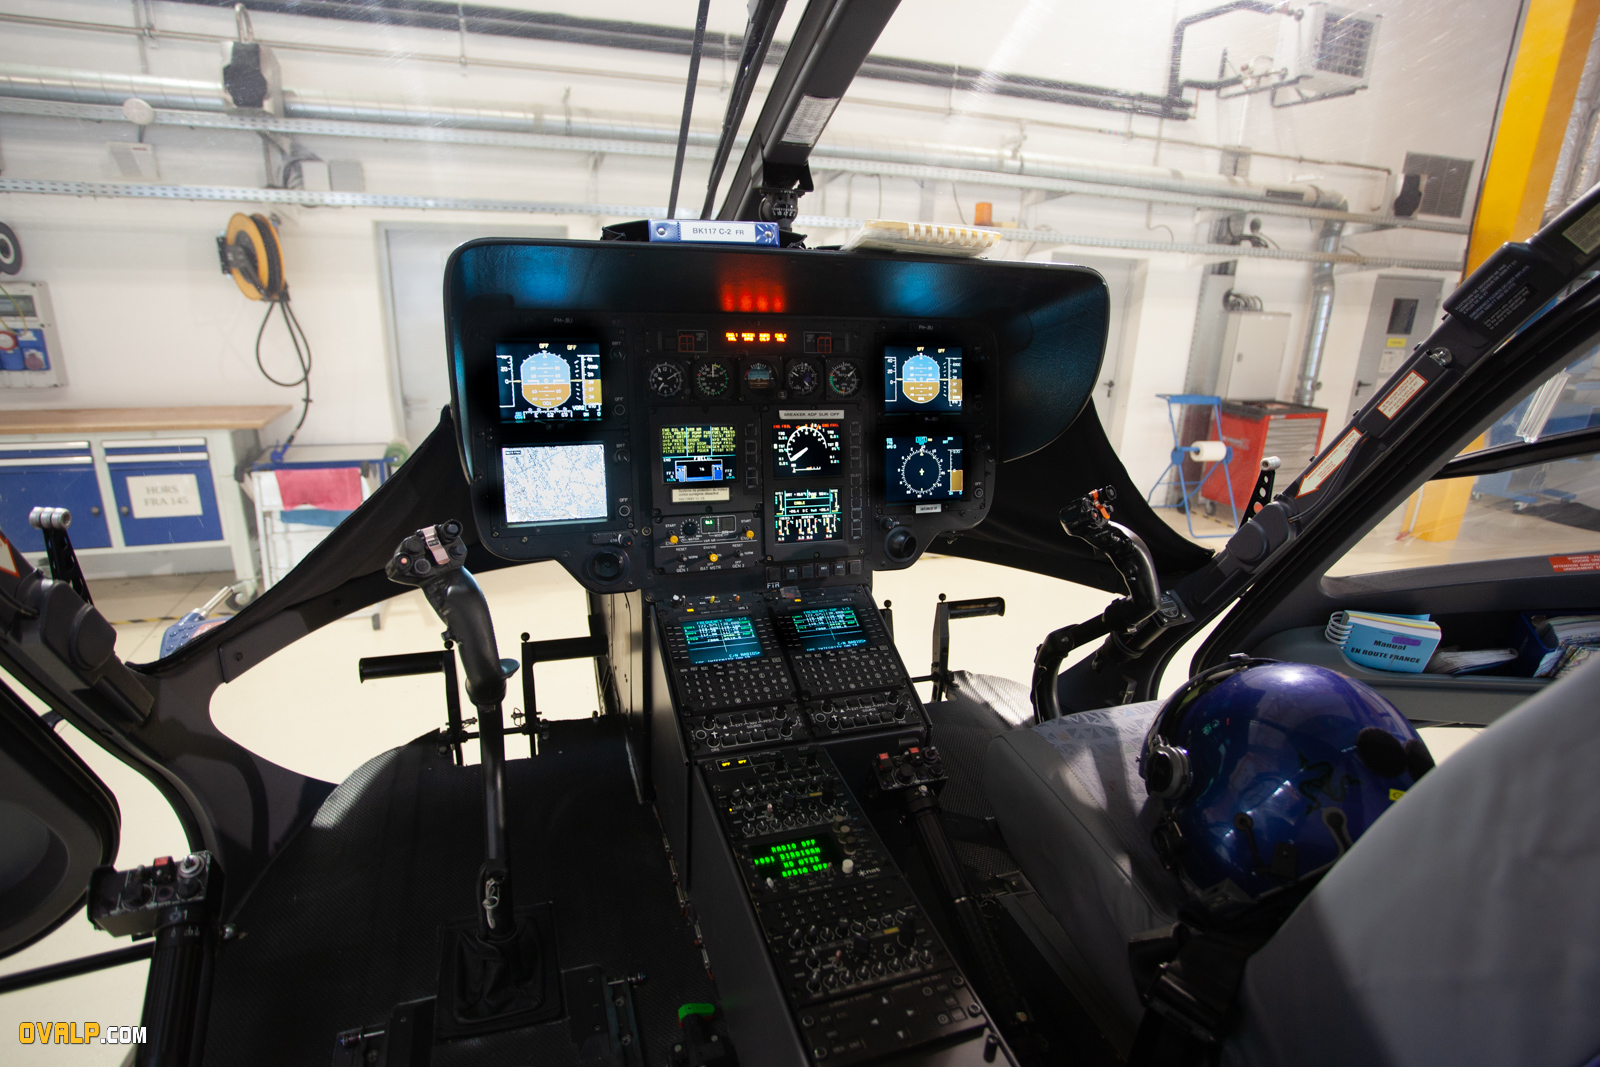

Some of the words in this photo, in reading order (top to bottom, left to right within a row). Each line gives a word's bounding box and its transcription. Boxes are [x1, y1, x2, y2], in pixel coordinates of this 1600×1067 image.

[145, 485, 180, 495] HORS
[143, 497, 168, 506] FRA
[170, 496, 189, 505] 145
[1362, 649, 1388, 658] ROUTE
[1389, 654, 1421, 663] FRANCE
[771, 843, 796, 853] RADIO
[801, 839, 815, 847] OFF
